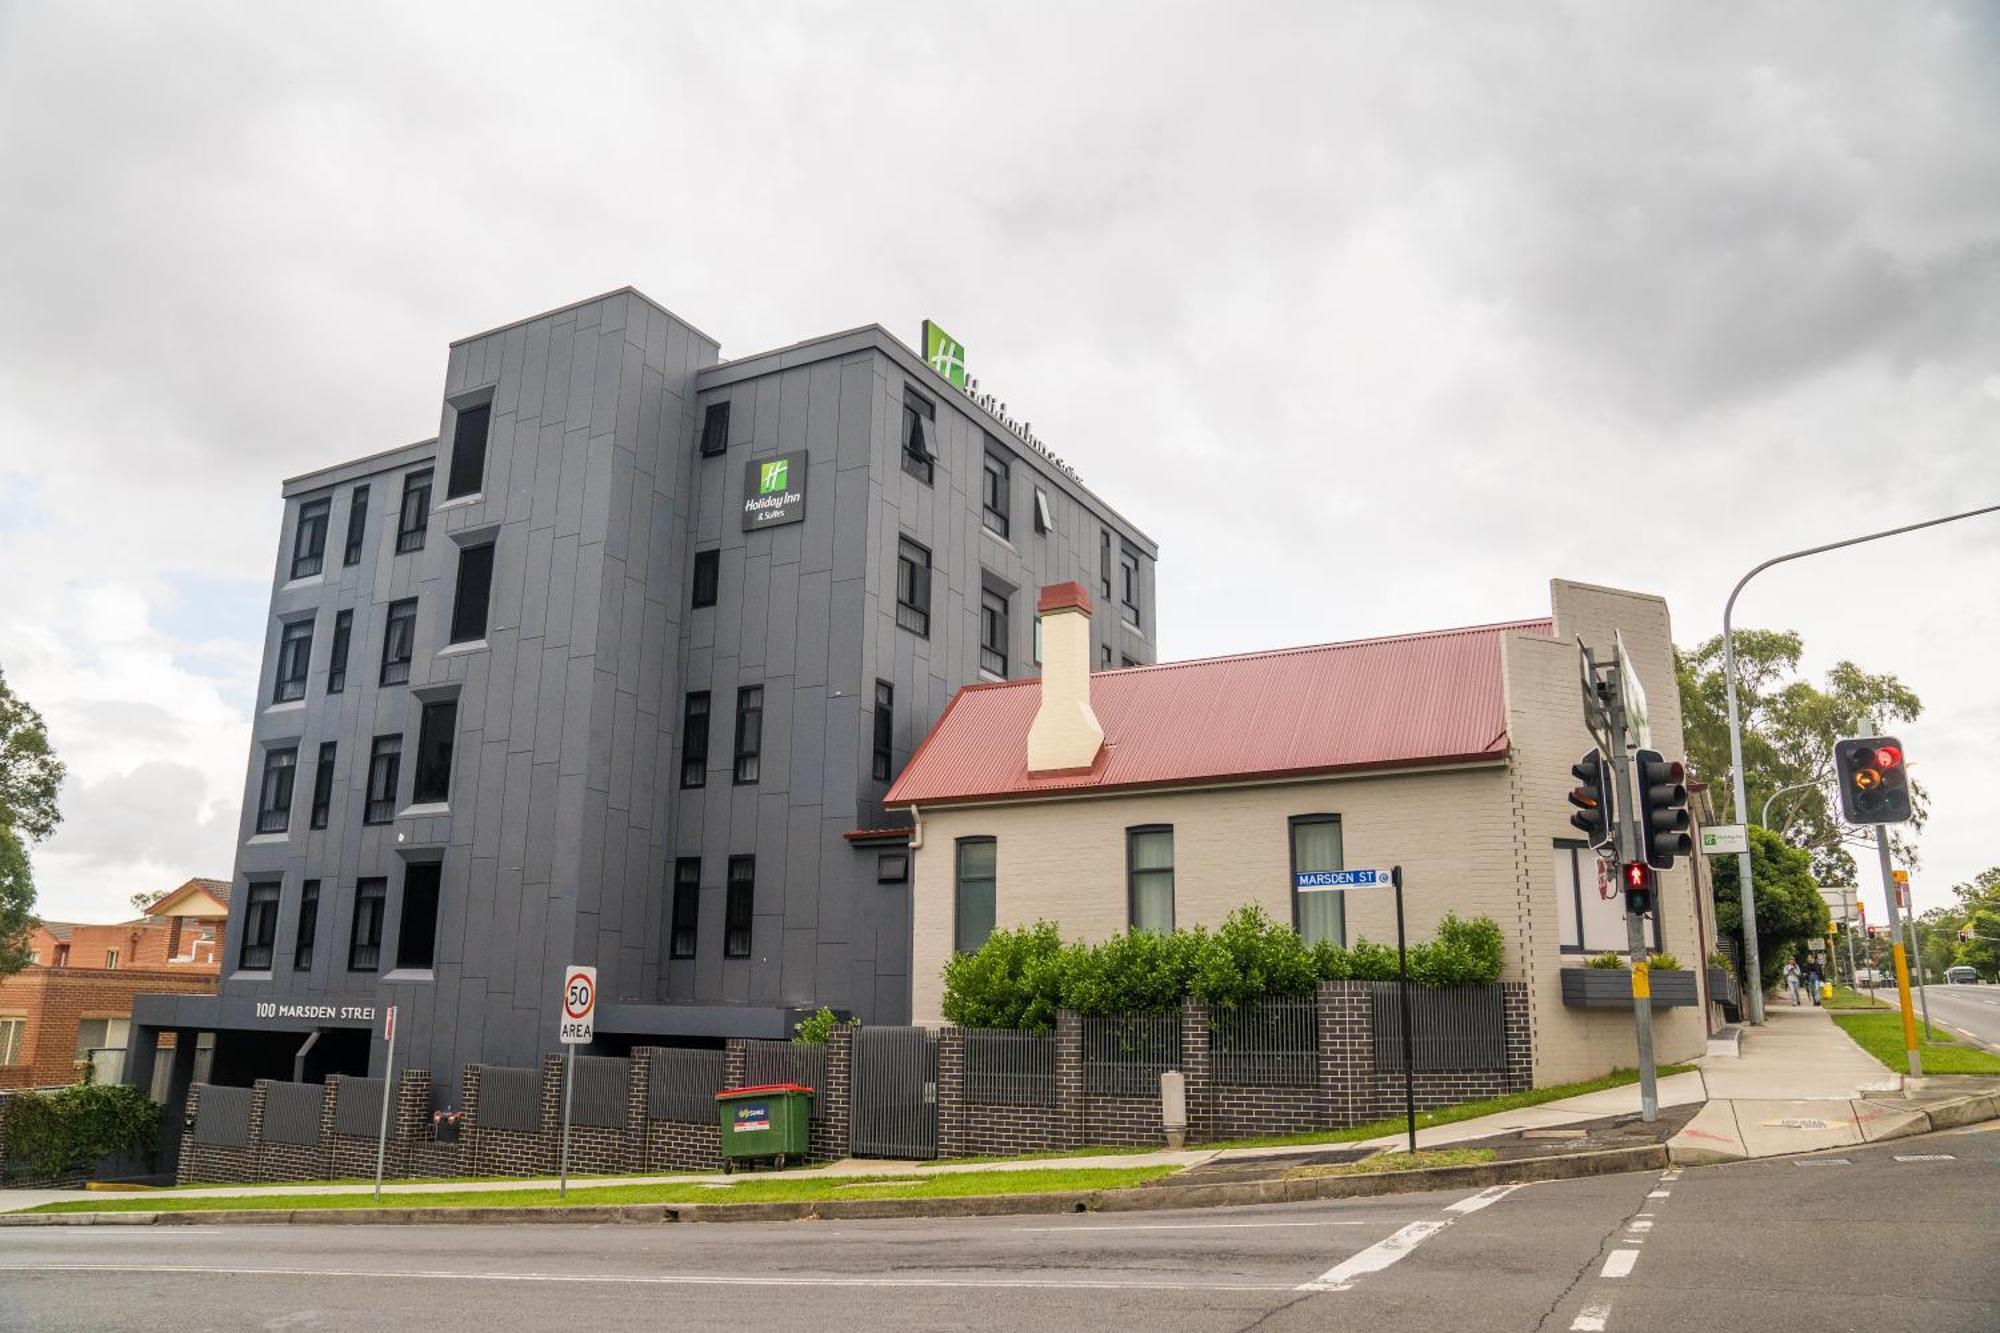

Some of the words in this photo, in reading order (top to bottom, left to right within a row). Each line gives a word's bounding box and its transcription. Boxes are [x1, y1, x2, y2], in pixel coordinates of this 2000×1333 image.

[745, 495, 783, 512] Holiday
[784, 491, 800, 505] Inn
[765, 510, 785, 520] Suites
[1299, 872, 1354, 886] MARSDEN
[1359, 871, 1374, 883] ST
[569, 986, 589, 1006] 50
[256, 1002, 276, 1018] 100
[279, 1005, 336, 1019] MARSDEN
[562, 1024, 592, 1038] AREA
